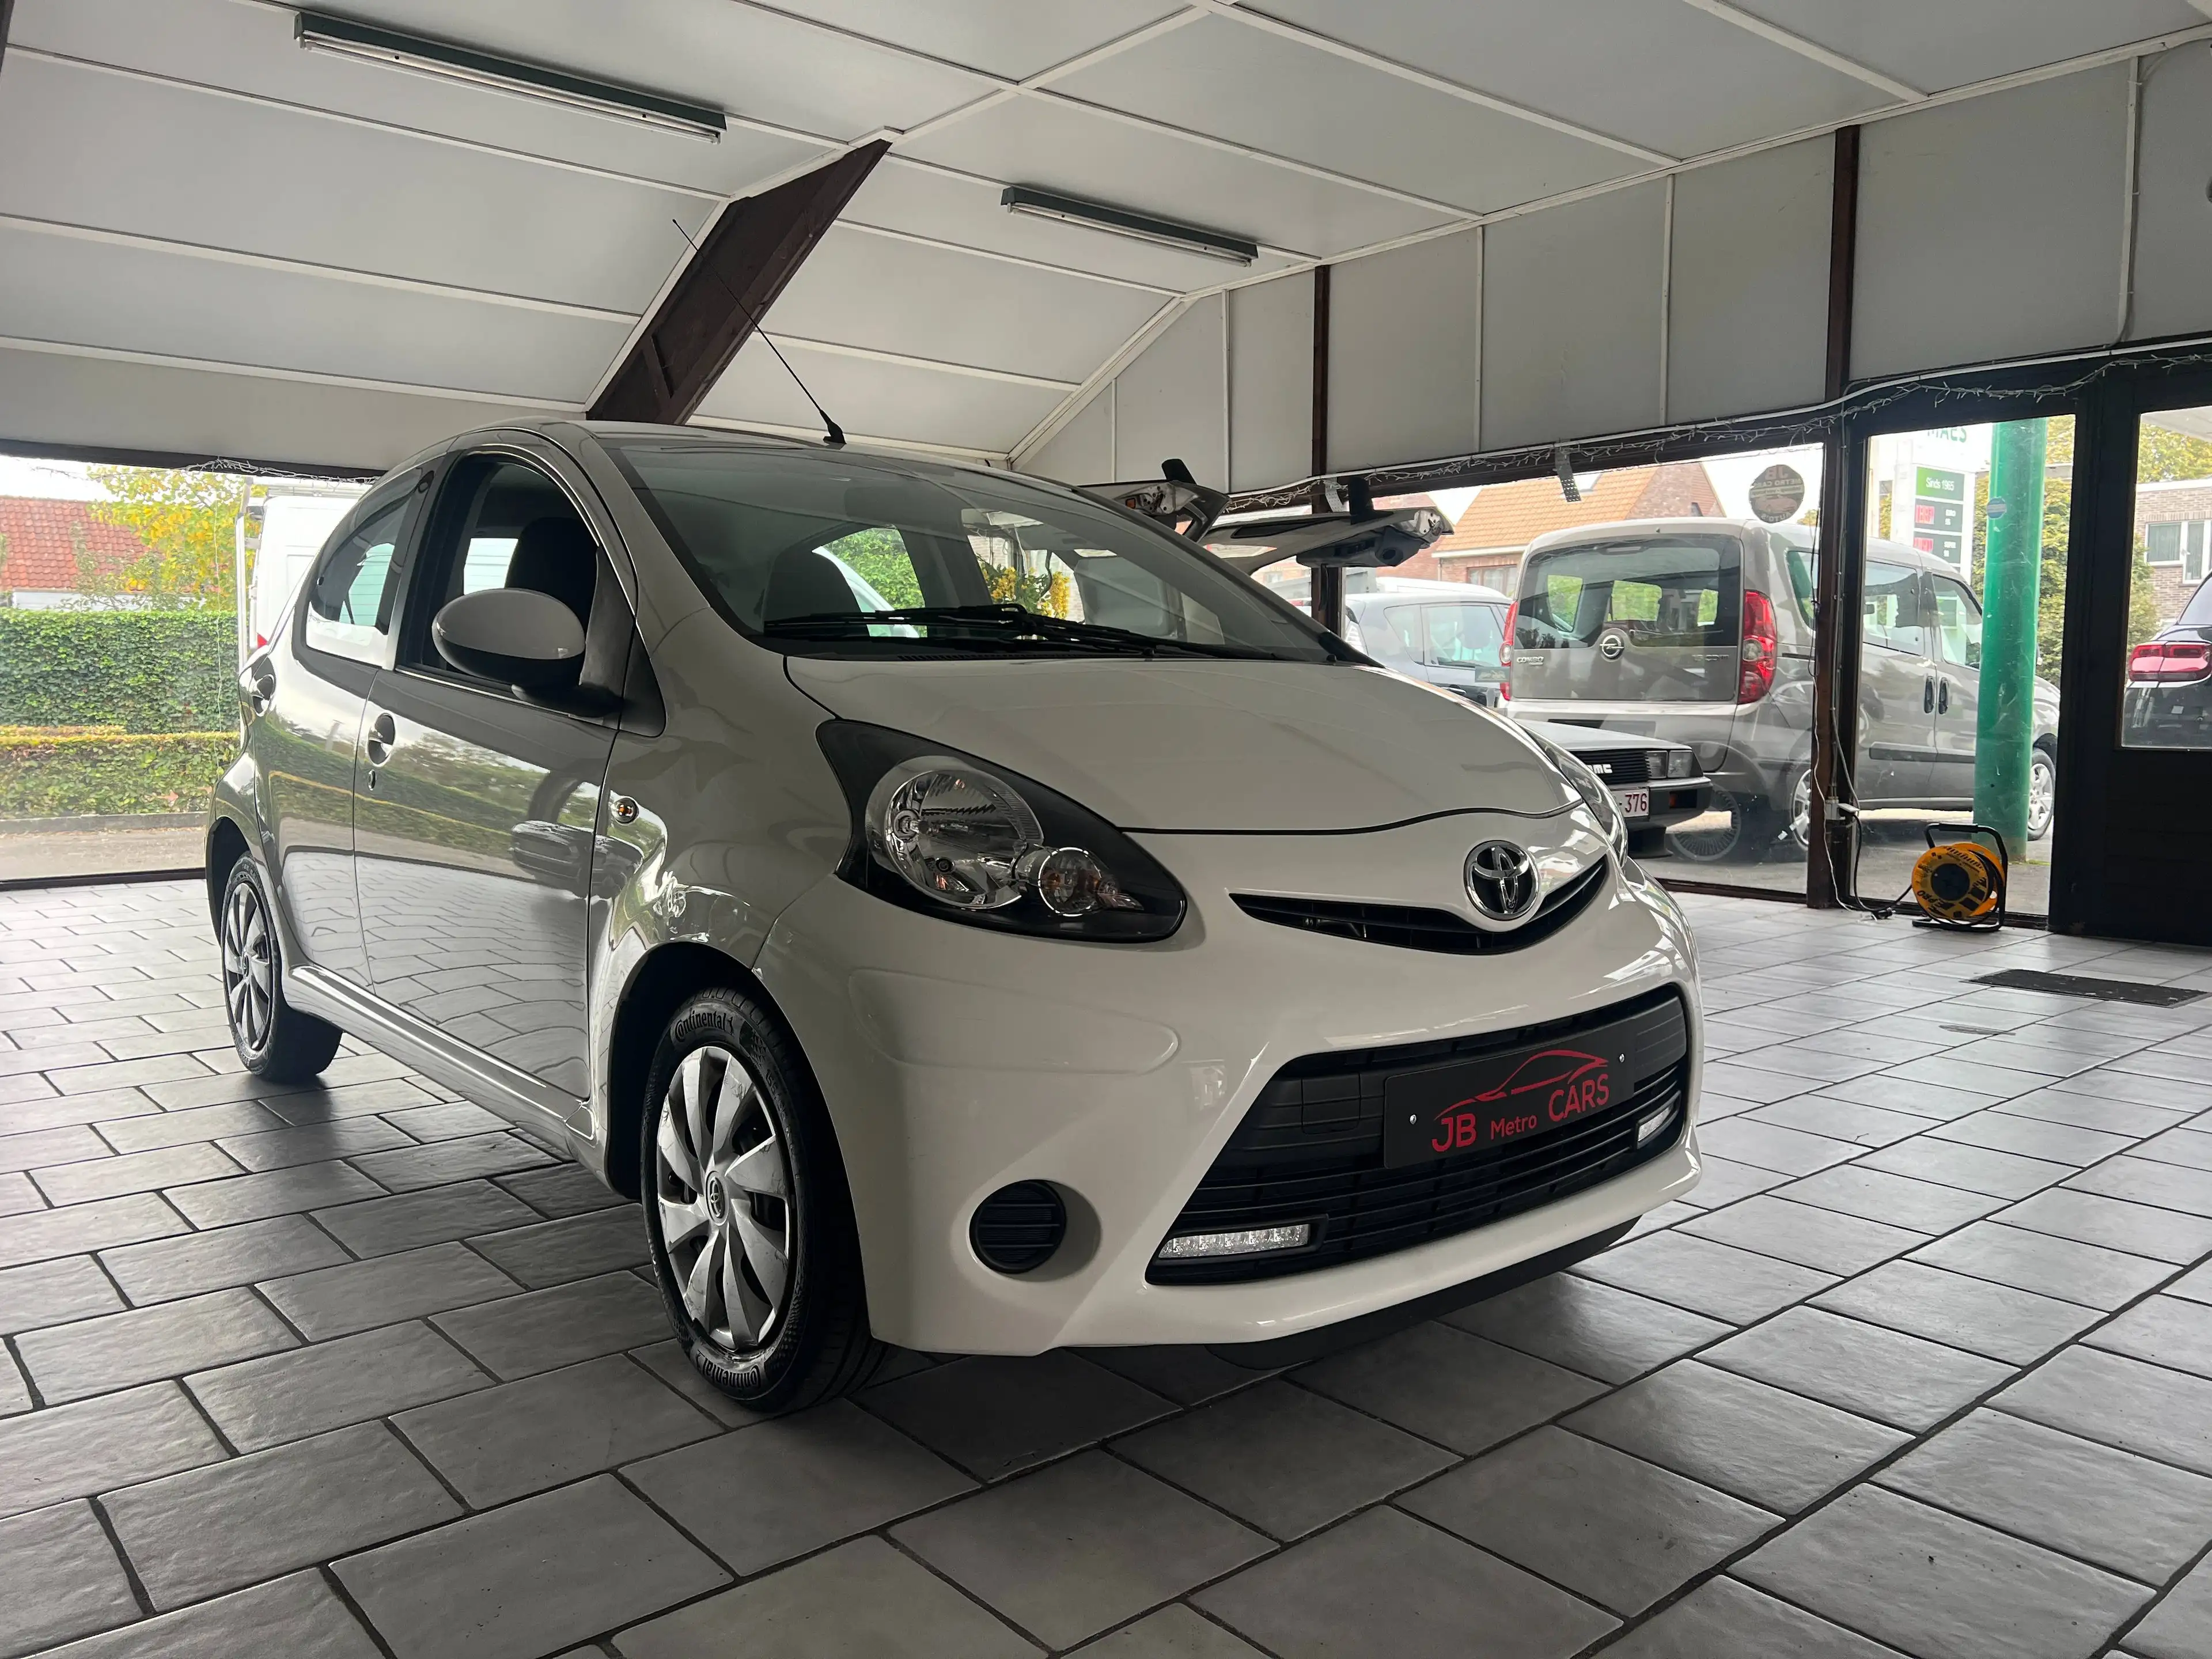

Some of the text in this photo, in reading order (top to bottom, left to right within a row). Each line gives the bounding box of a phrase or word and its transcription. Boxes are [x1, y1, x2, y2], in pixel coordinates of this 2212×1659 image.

[1941, 480, 1955, 491] 1965
[675, 1010, 727, 1042] Continental
[1431, 1073, 1609, 1152] JB Metro CARS
